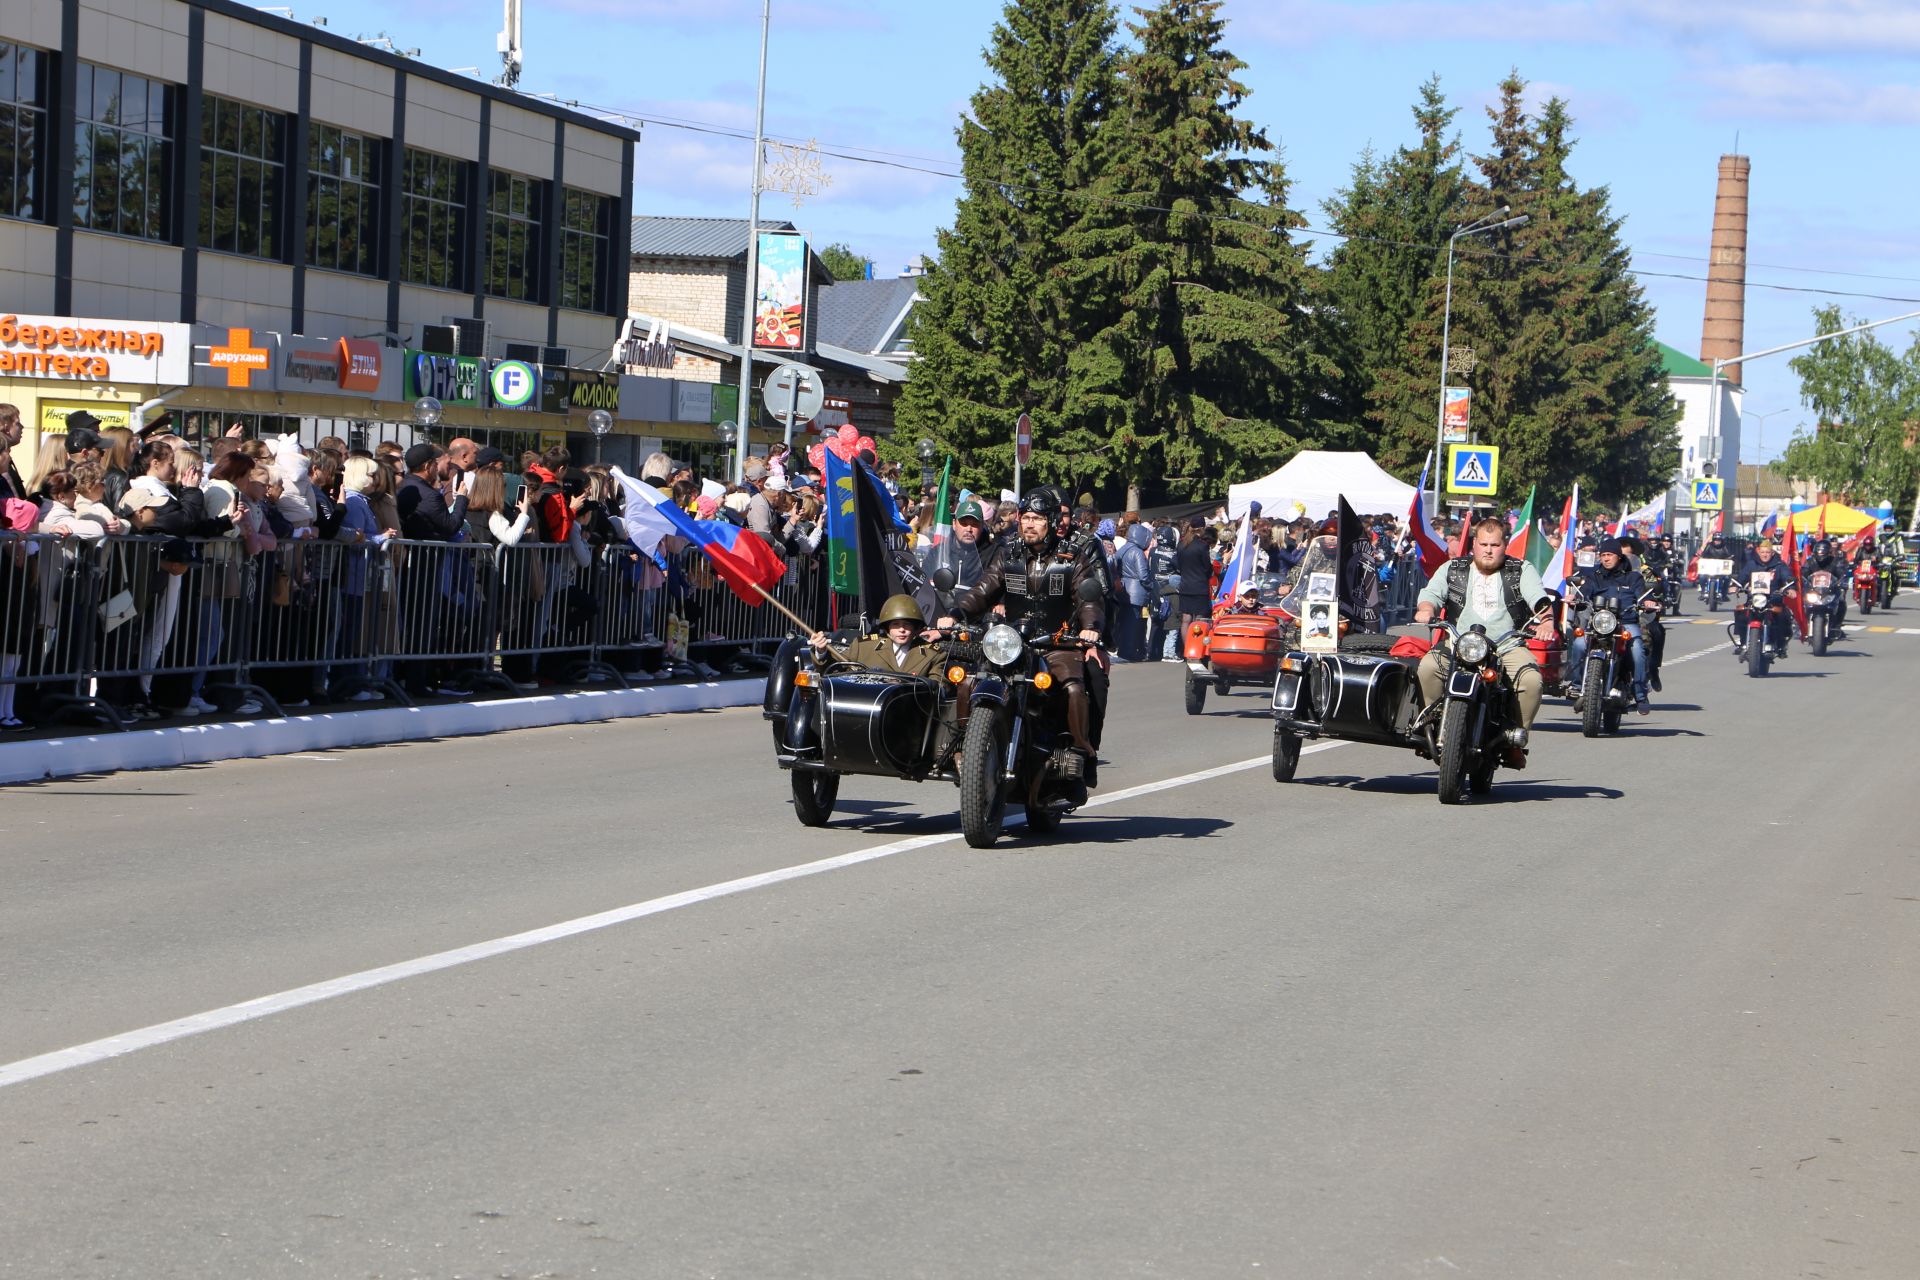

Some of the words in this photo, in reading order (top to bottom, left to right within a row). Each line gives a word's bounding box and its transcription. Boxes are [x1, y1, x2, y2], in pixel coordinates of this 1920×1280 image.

[0, 315, 161, 356] бережная
[0, 350, 107, 377] аптека
[503, 371, 520, 395] F
